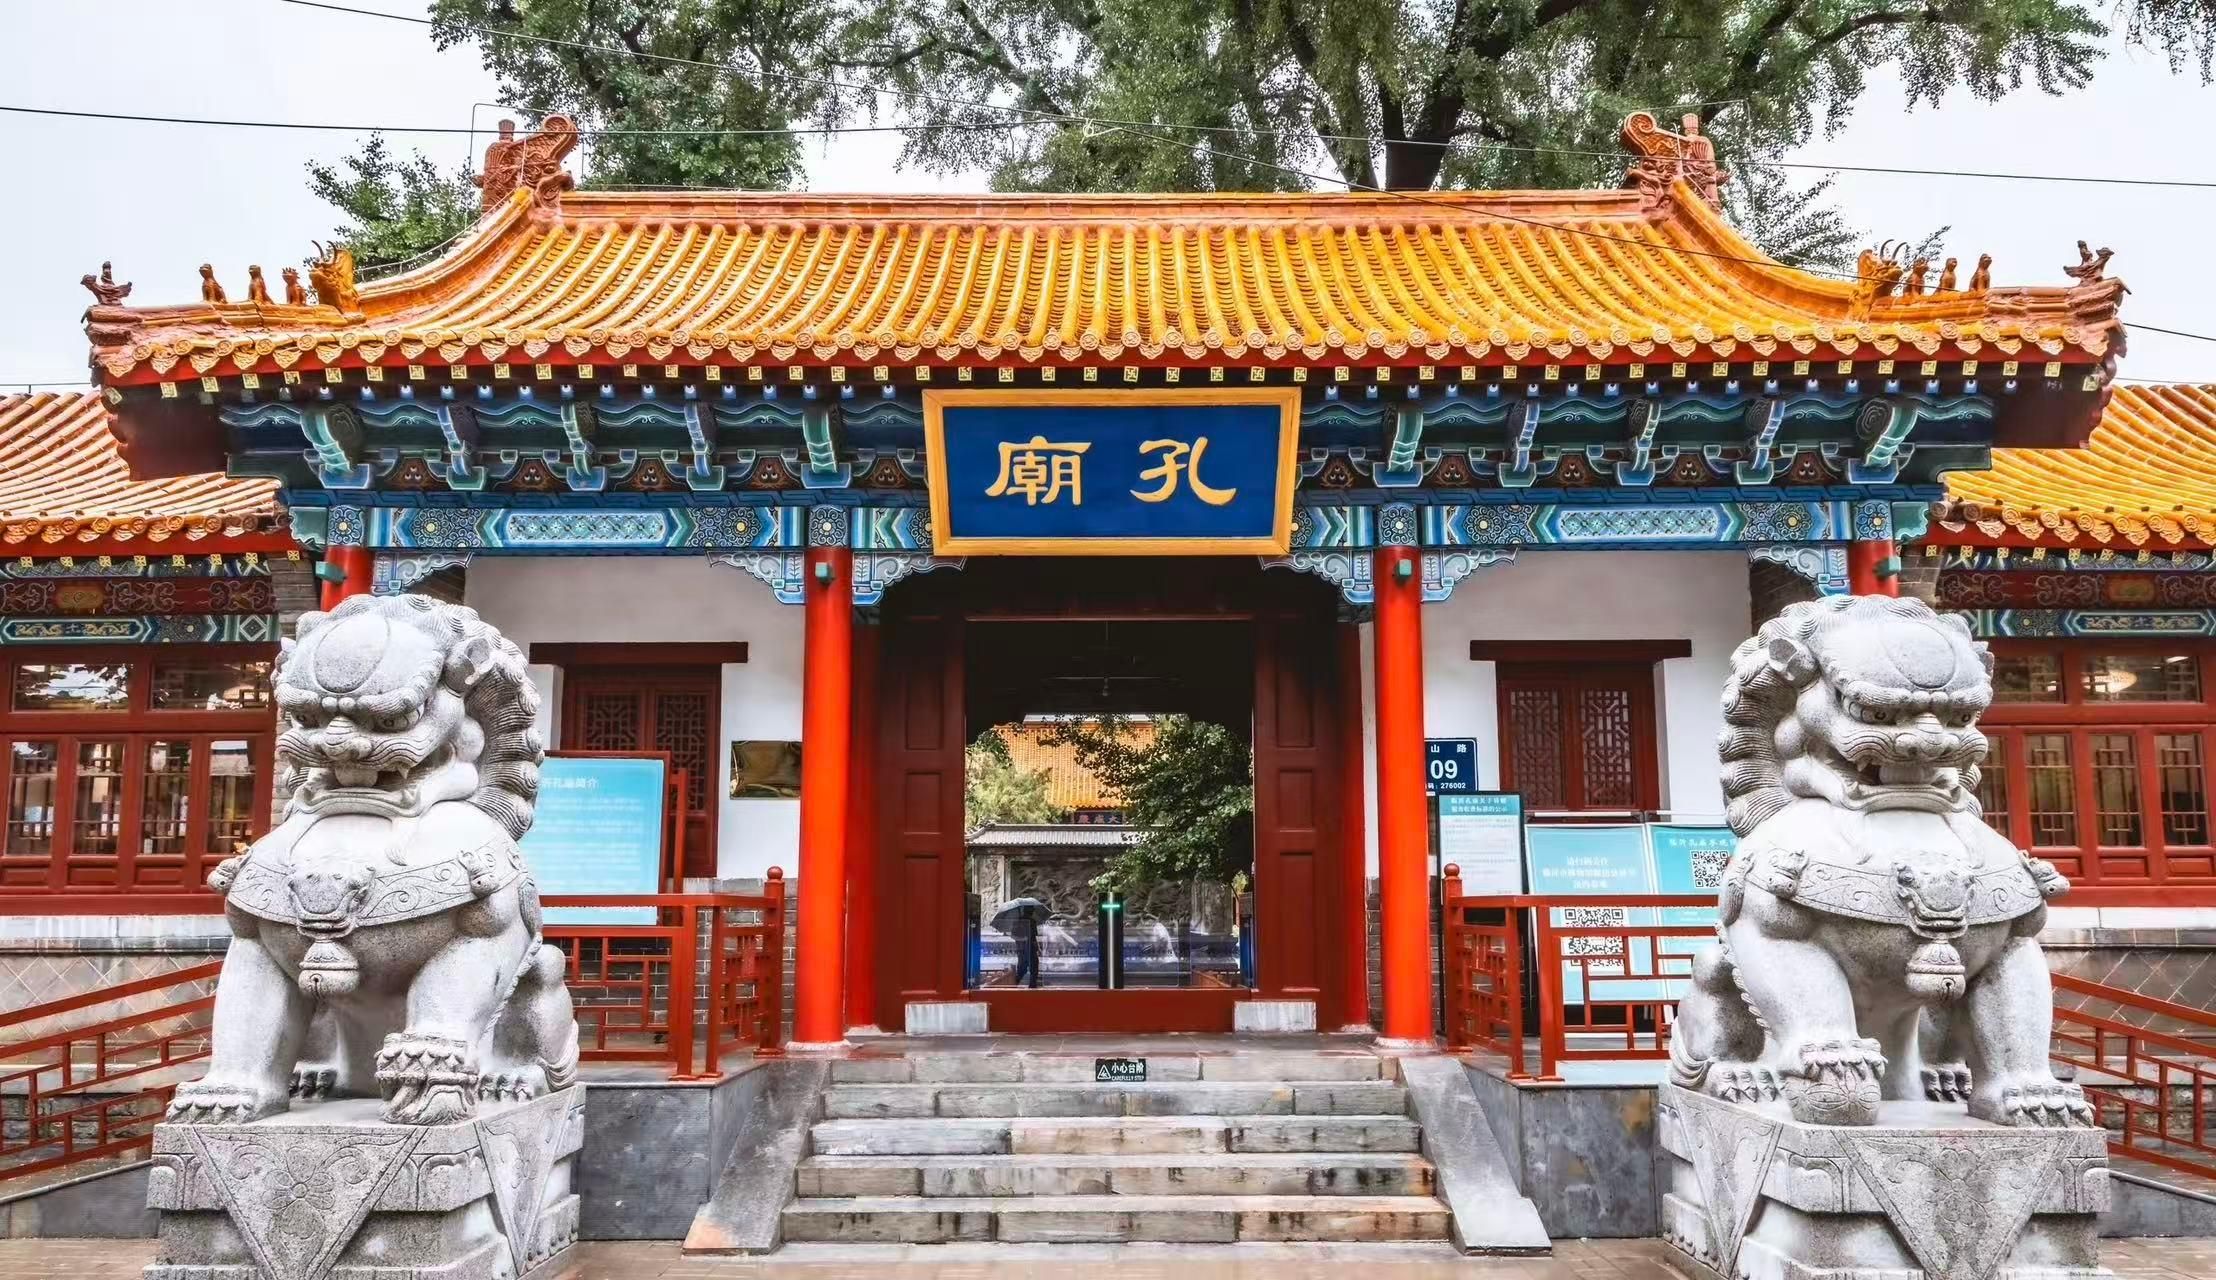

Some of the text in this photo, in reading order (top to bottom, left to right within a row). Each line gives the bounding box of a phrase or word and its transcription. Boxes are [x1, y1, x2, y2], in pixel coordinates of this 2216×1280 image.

[1430, 760, 1458, 779] 09
[1111, 1062, 1144, 1074] 小心台阶
